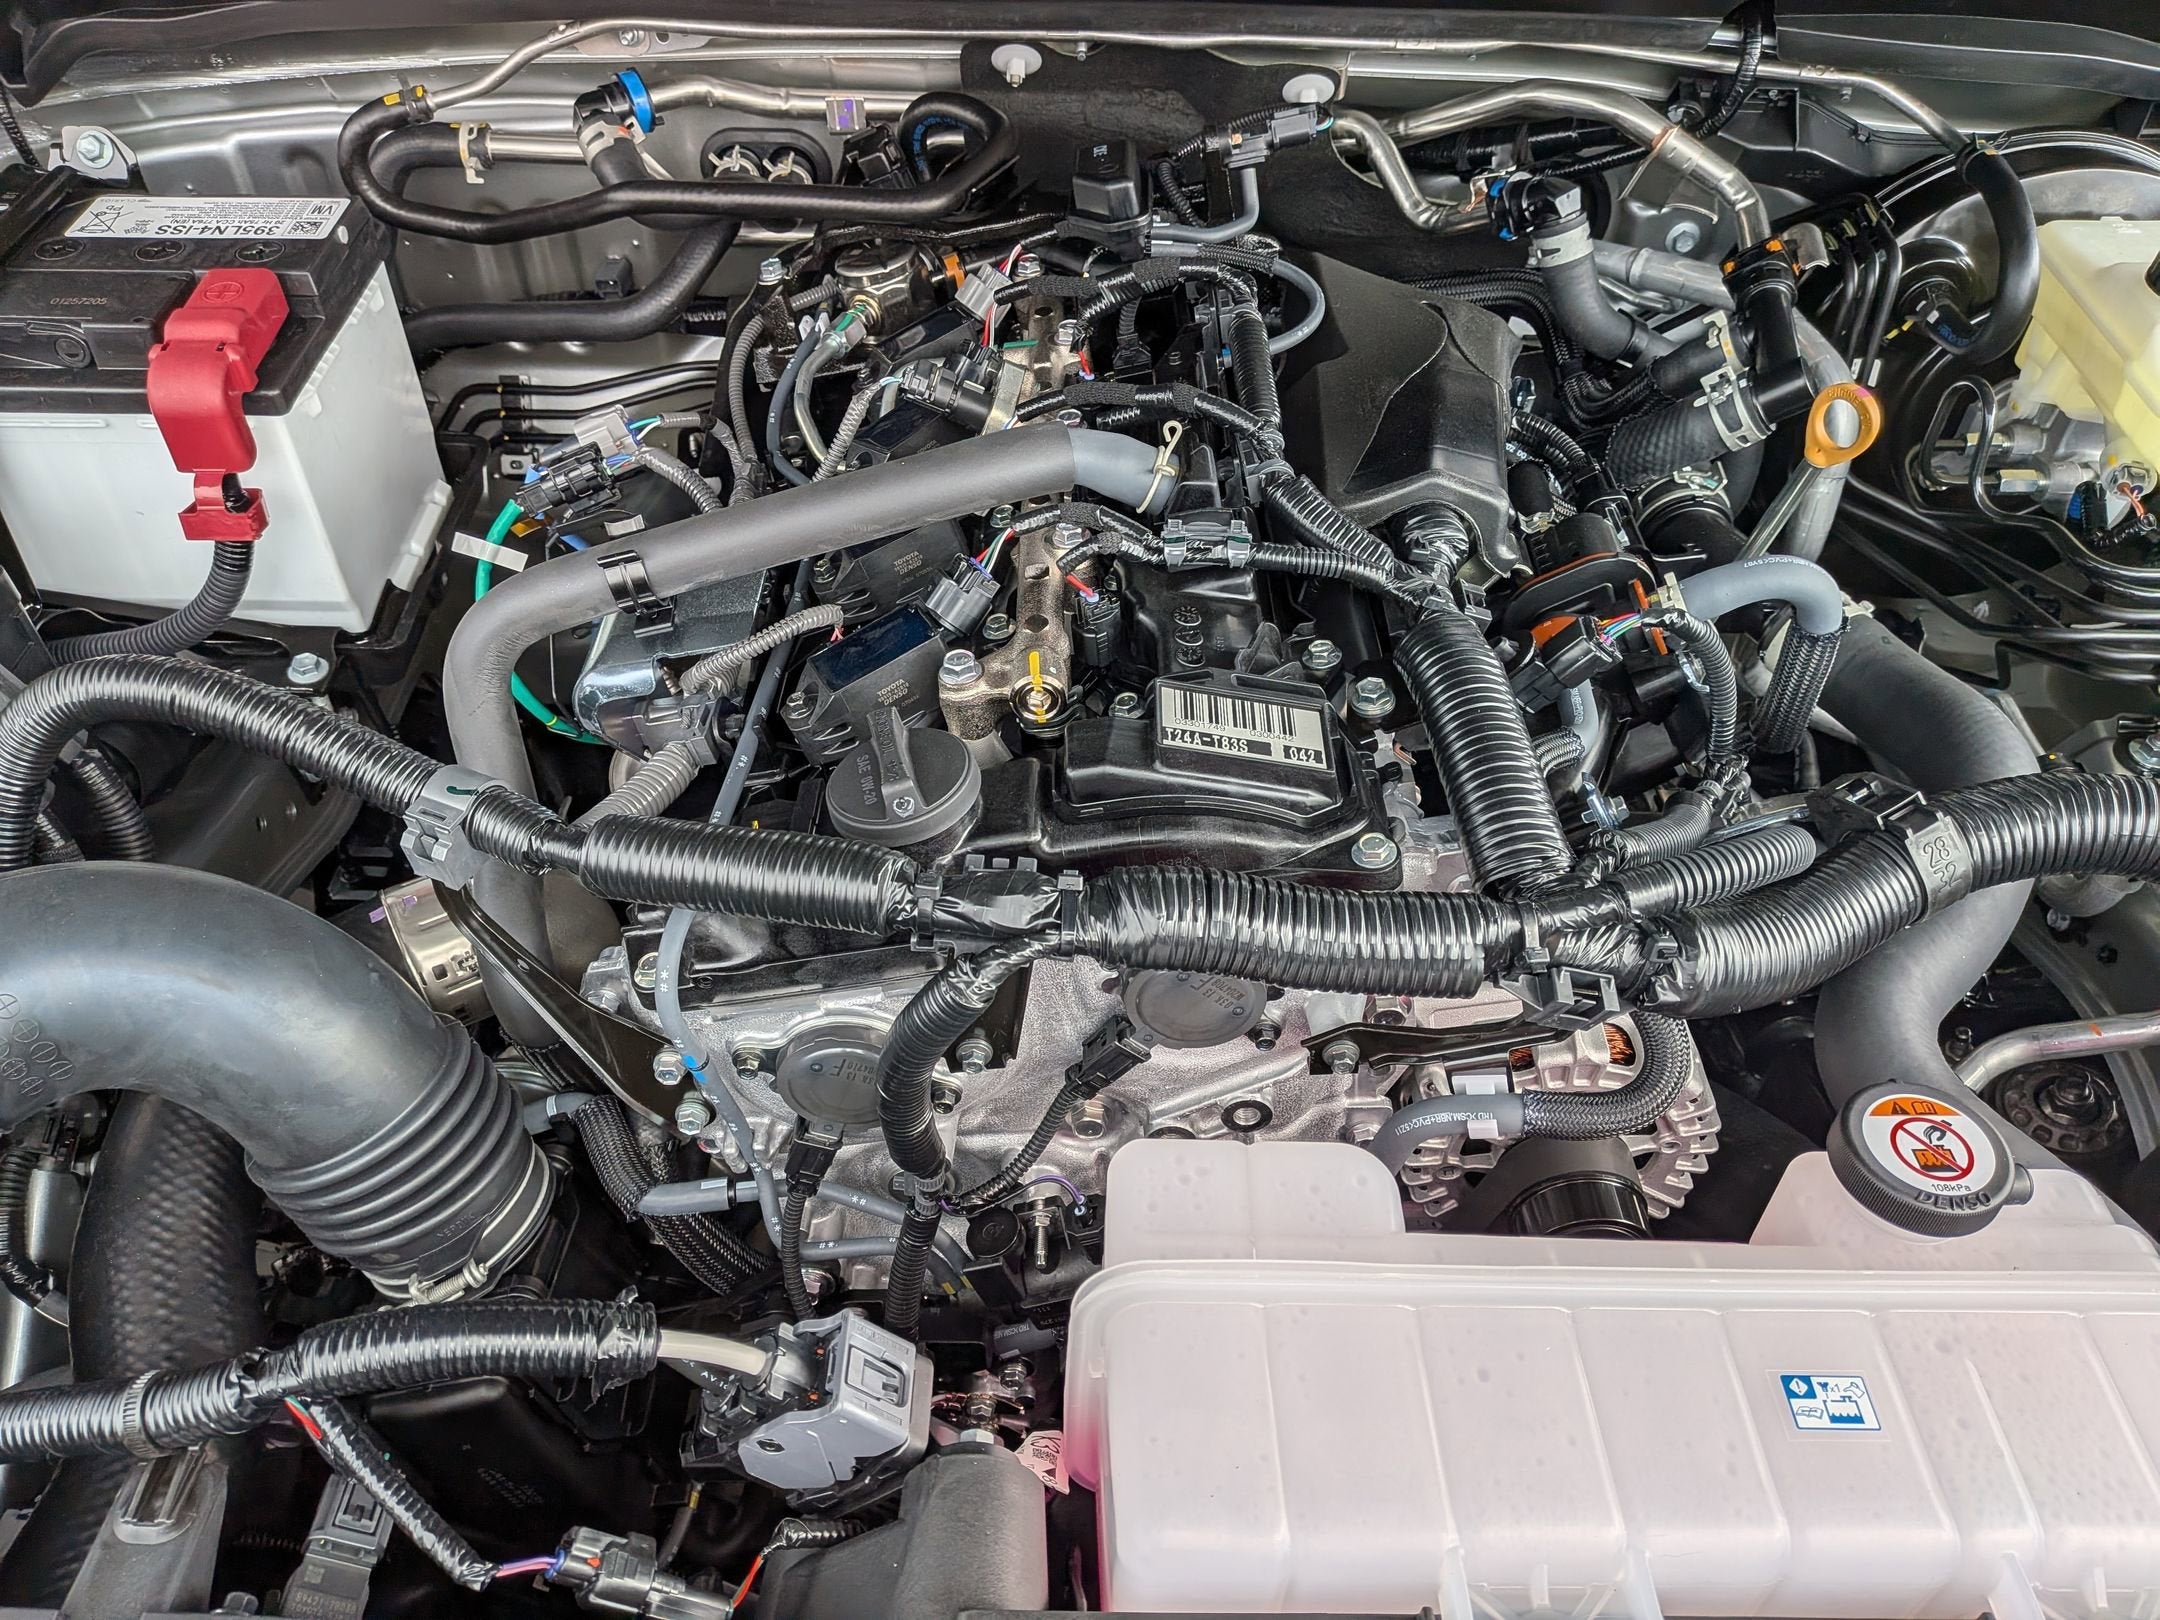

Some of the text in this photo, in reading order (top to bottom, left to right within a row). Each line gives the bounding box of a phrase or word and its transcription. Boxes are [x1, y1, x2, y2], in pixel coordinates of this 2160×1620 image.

[105, 204, 124, 212] Pb
[154, 224, 281, 236] 395LN4-ISS
[50, 297, 108, 306] 01257205
[893, 551, 920, 567] TOYOTA
[899, 560, 923, 576] DENSO
[876, 678, 906, 697] TOYOTA
[883, 688, 909, 706] DENSO
[1174, 717, 1295, 742] 03301749 0300442
[1165, 727, 1316, 763] T24A-T83S 042
[856, 754, 878, 805] SAE 0W-20
[1922, 835, 1951, 869] 28
[1933, 860, 1962, 893] 32
[829, 1058, 847, 1077] F
[1931, 1183, 1972, 1193] 108kPa
[1914, 1191, 1993, 1211] DENSO
